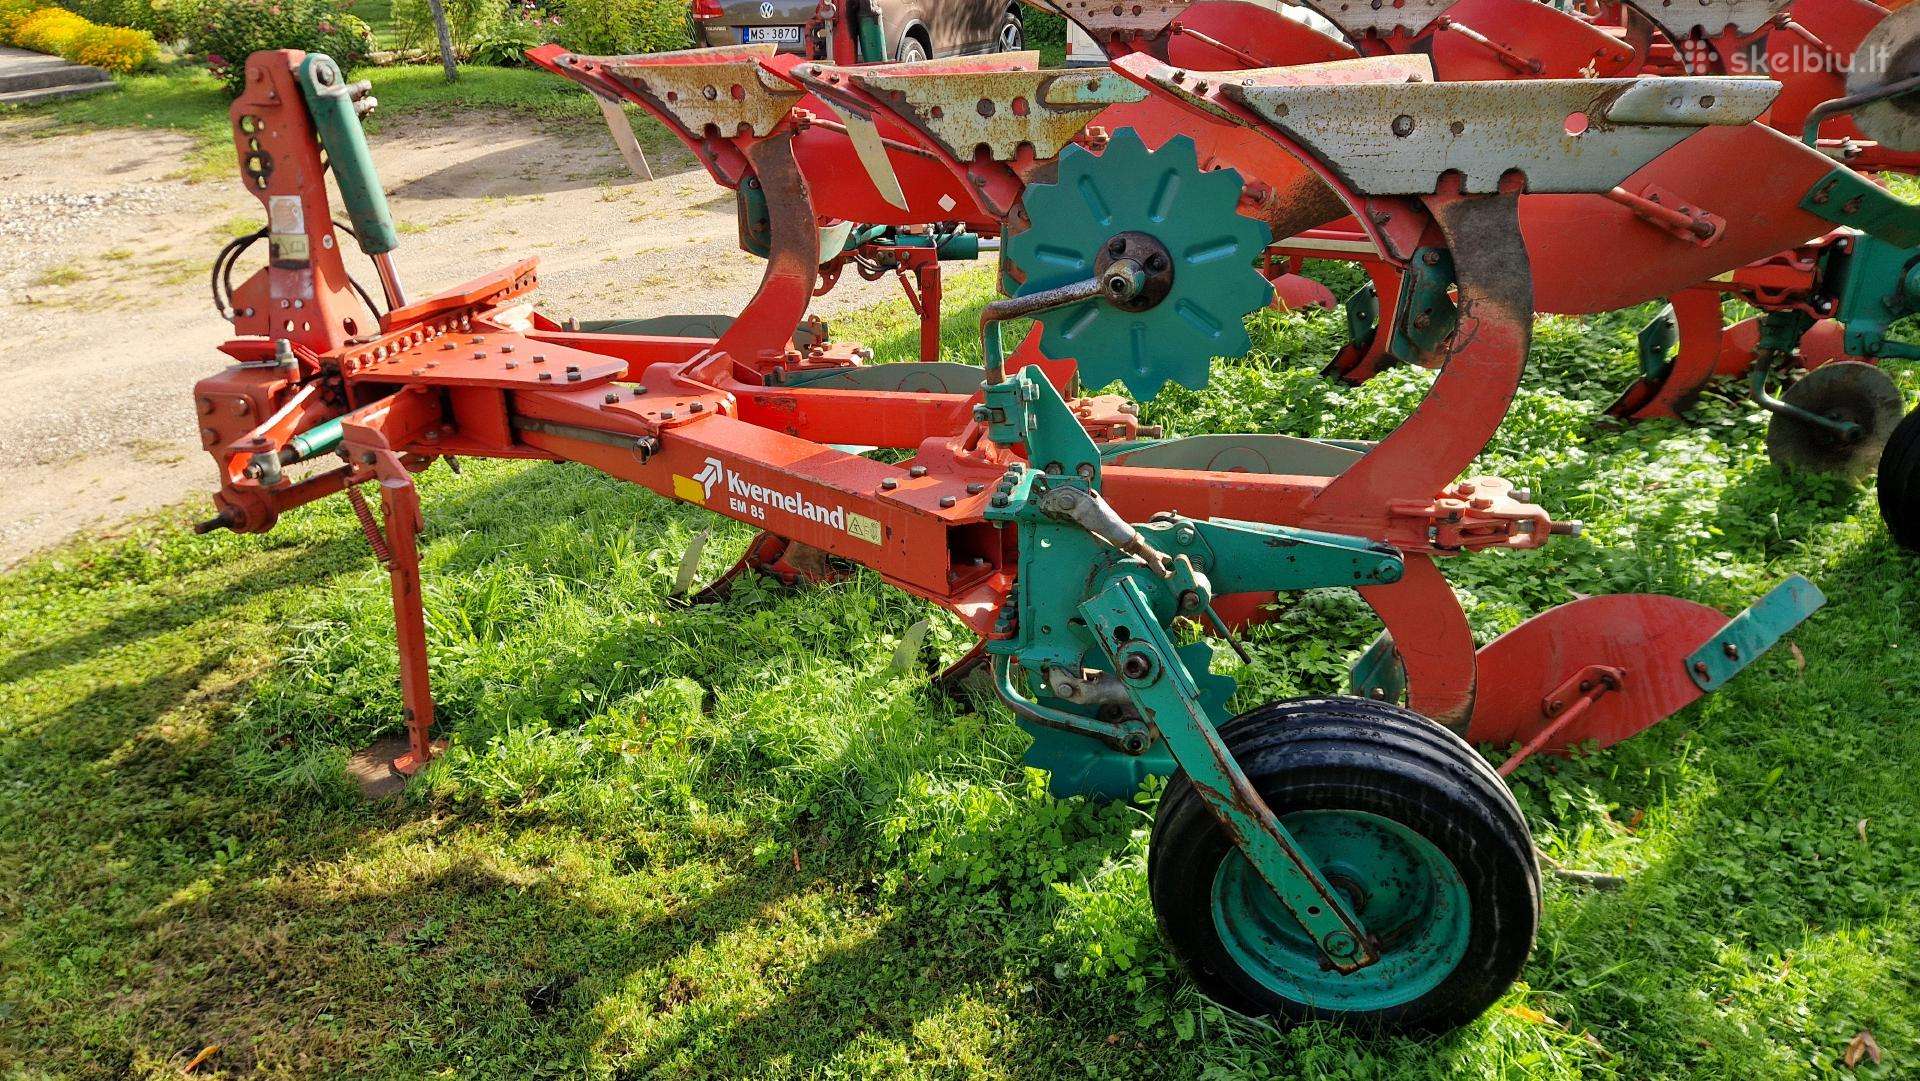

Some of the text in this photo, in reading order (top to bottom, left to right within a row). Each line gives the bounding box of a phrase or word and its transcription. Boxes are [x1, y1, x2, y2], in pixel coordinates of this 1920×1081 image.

[726, 469, 845, 531] Kverneland
[729, 498, 765, 520] EM 85
